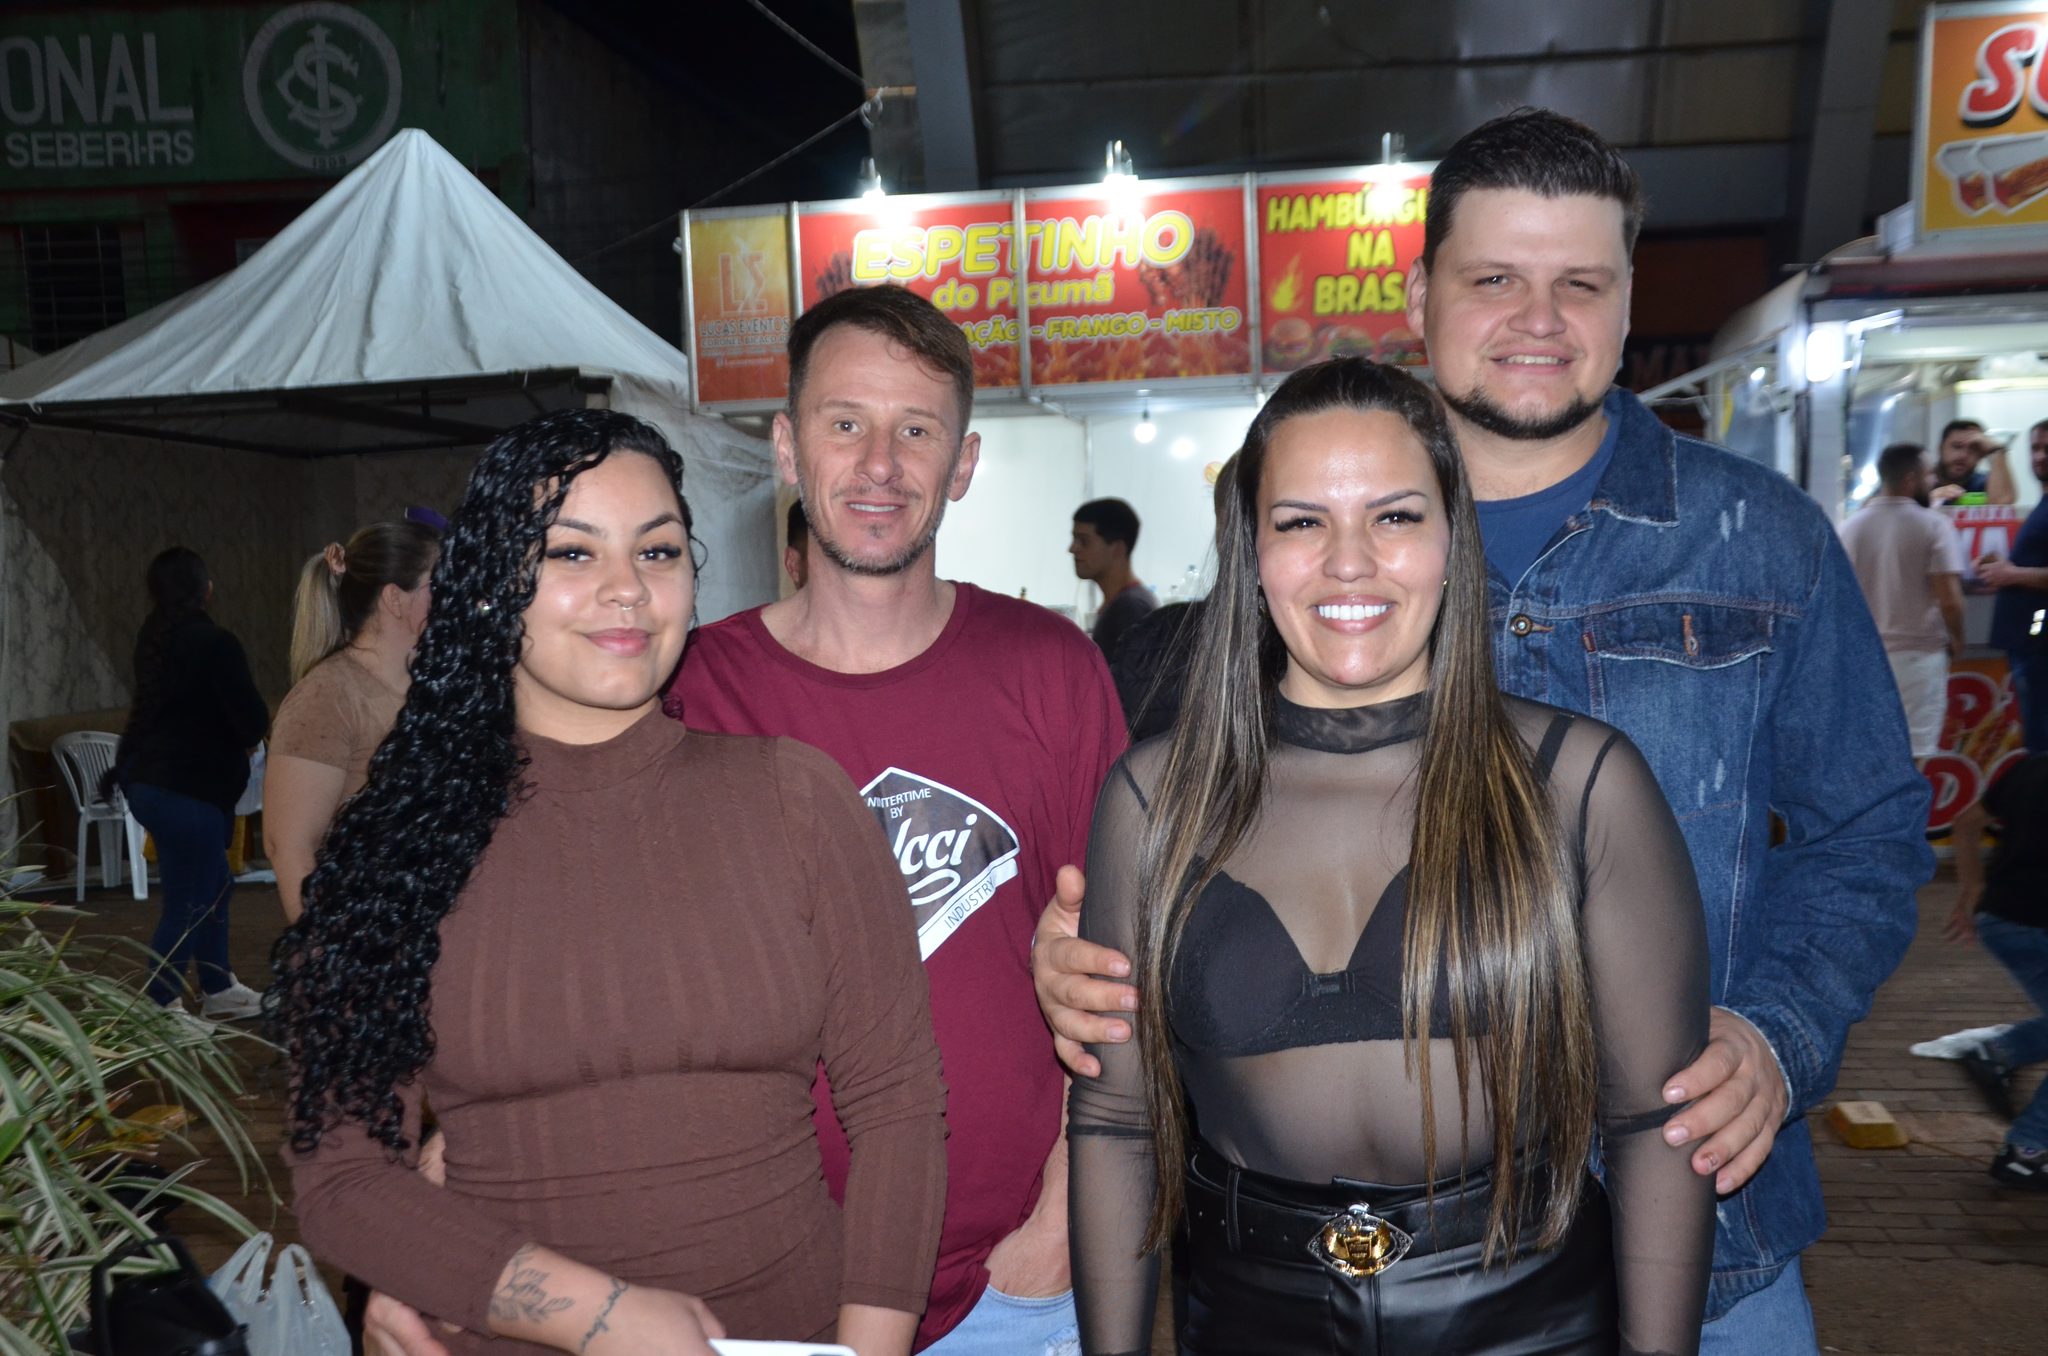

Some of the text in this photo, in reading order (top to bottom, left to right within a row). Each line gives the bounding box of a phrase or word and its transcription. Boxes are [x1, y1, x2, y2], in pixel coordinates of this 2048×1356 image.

[0, 32, 195, 127] ONAL
[854, 210, 1194, 283] ESPETINHO
[1347, 229, 1396, 270] NA
[933, 277, 978, 311] do
[1313, 271, 1407, 315] BRAS
[701, 316, 790, 336] LUCAS EVENTOS
[1046, 313, 1146, 341] FRANGO
[1164, 307, 1240, 334] MISTO
[890, 805, 904, 819] BY
[944, 876, 996, 930] INDUSTRY
